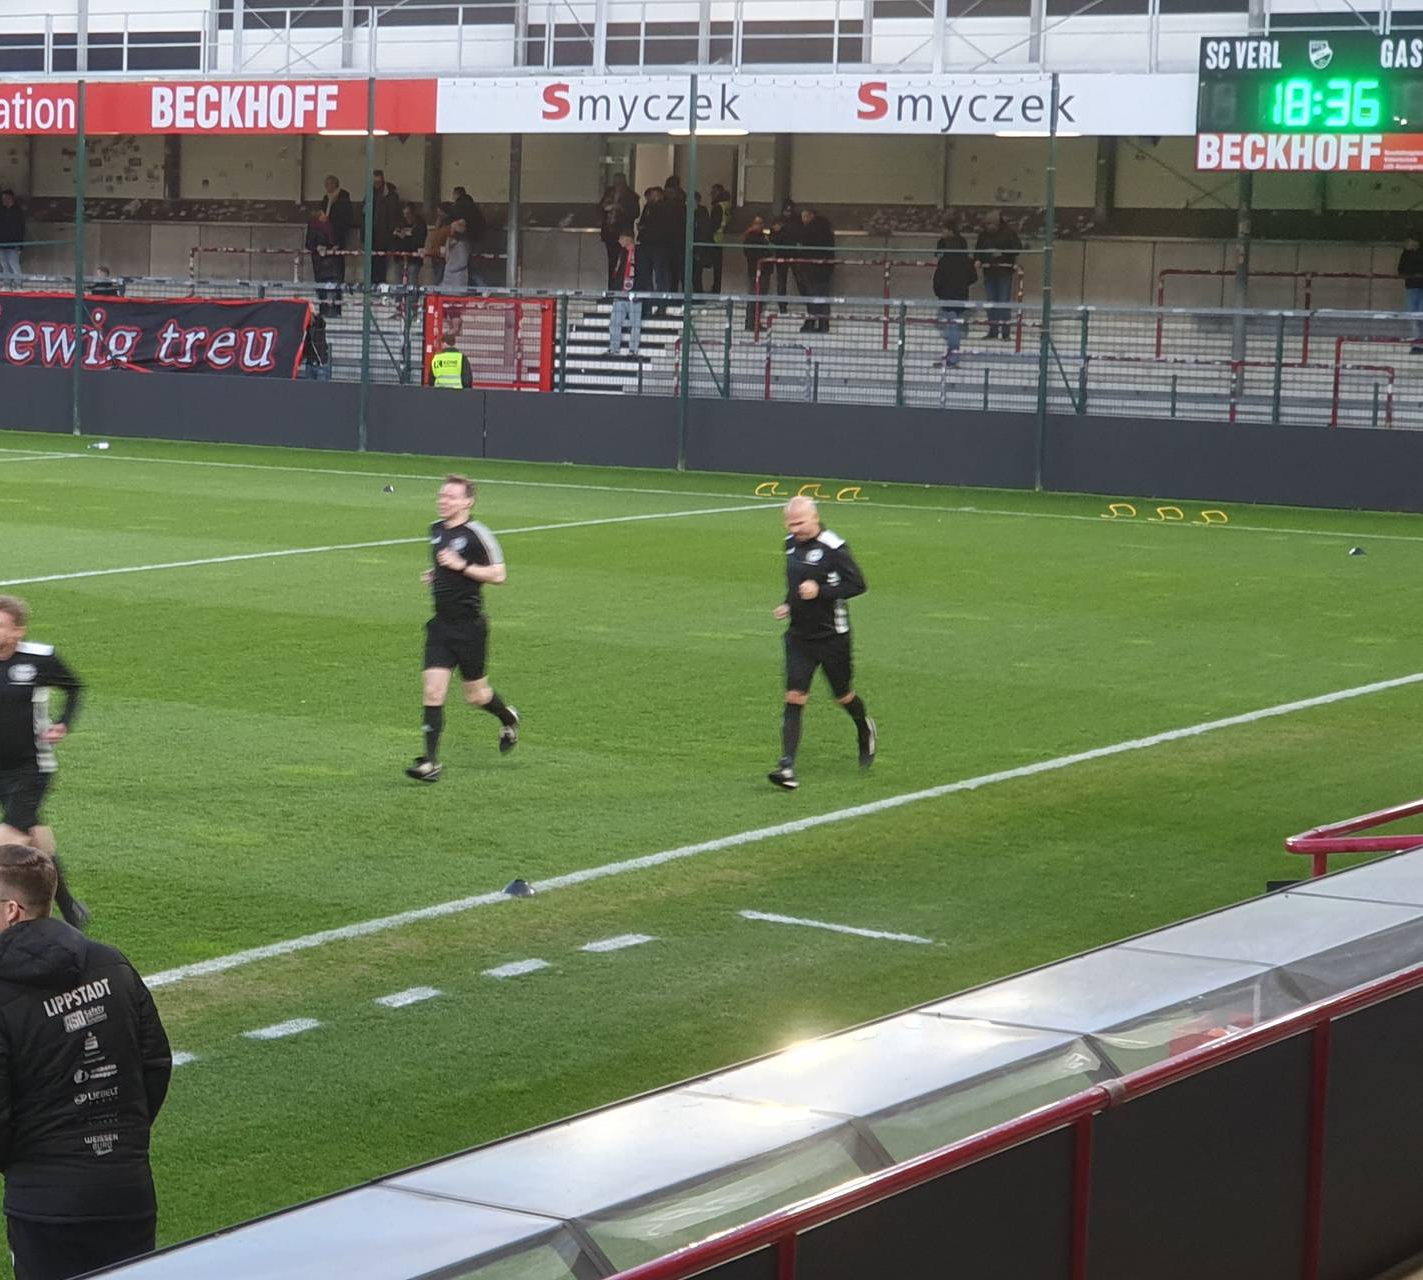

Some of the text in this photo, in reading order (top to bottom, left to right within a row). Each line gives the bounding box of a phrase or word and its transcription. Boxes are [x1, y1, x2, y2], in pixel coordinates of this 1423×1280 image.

[1206, 40, 1282, 69] SC VERL
[151, 85, 339, 129] BECKHOFF
[542, 83, 741, 132] Smyczek
[856, 81, 1076, 133] Smyczek
[1272, 79, 1381, 128] 18:36
[1196, 133, 1383, 170] BECKHOFF
[8, 311, 138, 365] ewig
[158, 322, 274, 368] treu
[43, 978, 112, 1018] LIPPSTADT
